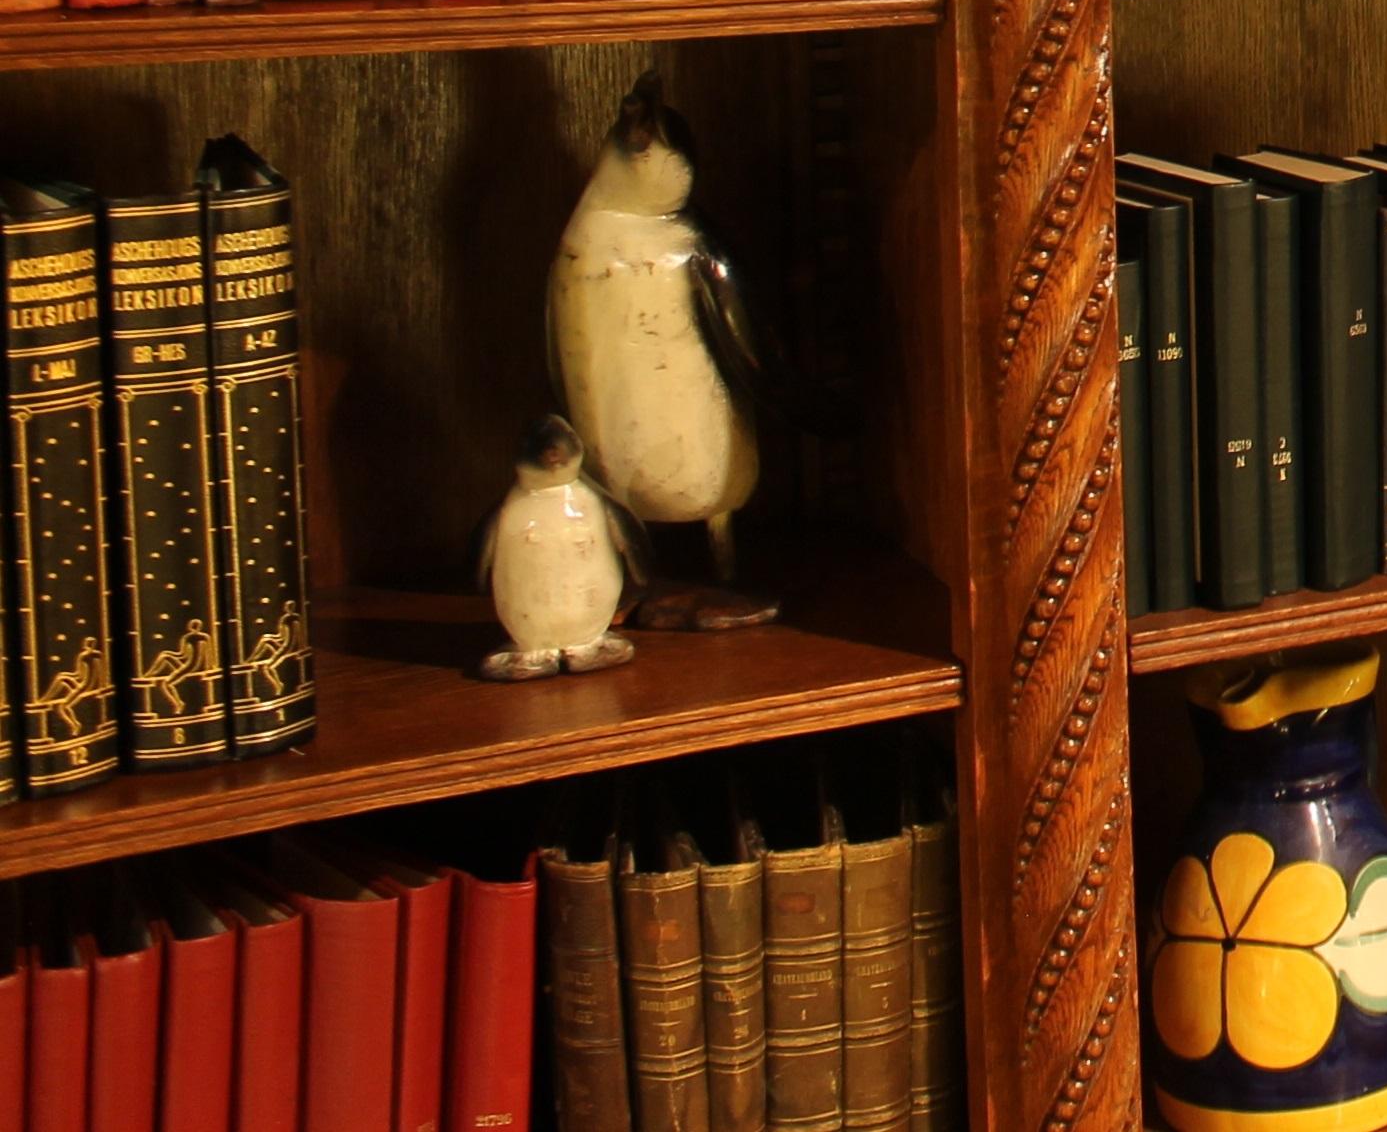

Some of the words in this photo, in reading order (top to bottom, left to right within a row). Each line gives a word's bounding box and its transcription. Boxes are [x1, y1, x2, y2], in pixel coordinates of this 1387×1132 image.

[112, 235, 201, 262] ASCHEHOUGS
[9, 248, 96, 279] ASCHEHOUGS
[113, 285, 204, 311] LEKSIKON
[11, 297, 98, 329] LEKSIKON
[1356, 308, 1363, 321] N
[1124, 334, 1133, 347] N
[1168, 332, 1176, 344] N
[1236, 455, 1245, 468] N
[275, 707, 285, 723] 1
[69, 746, 88, 766] 12
